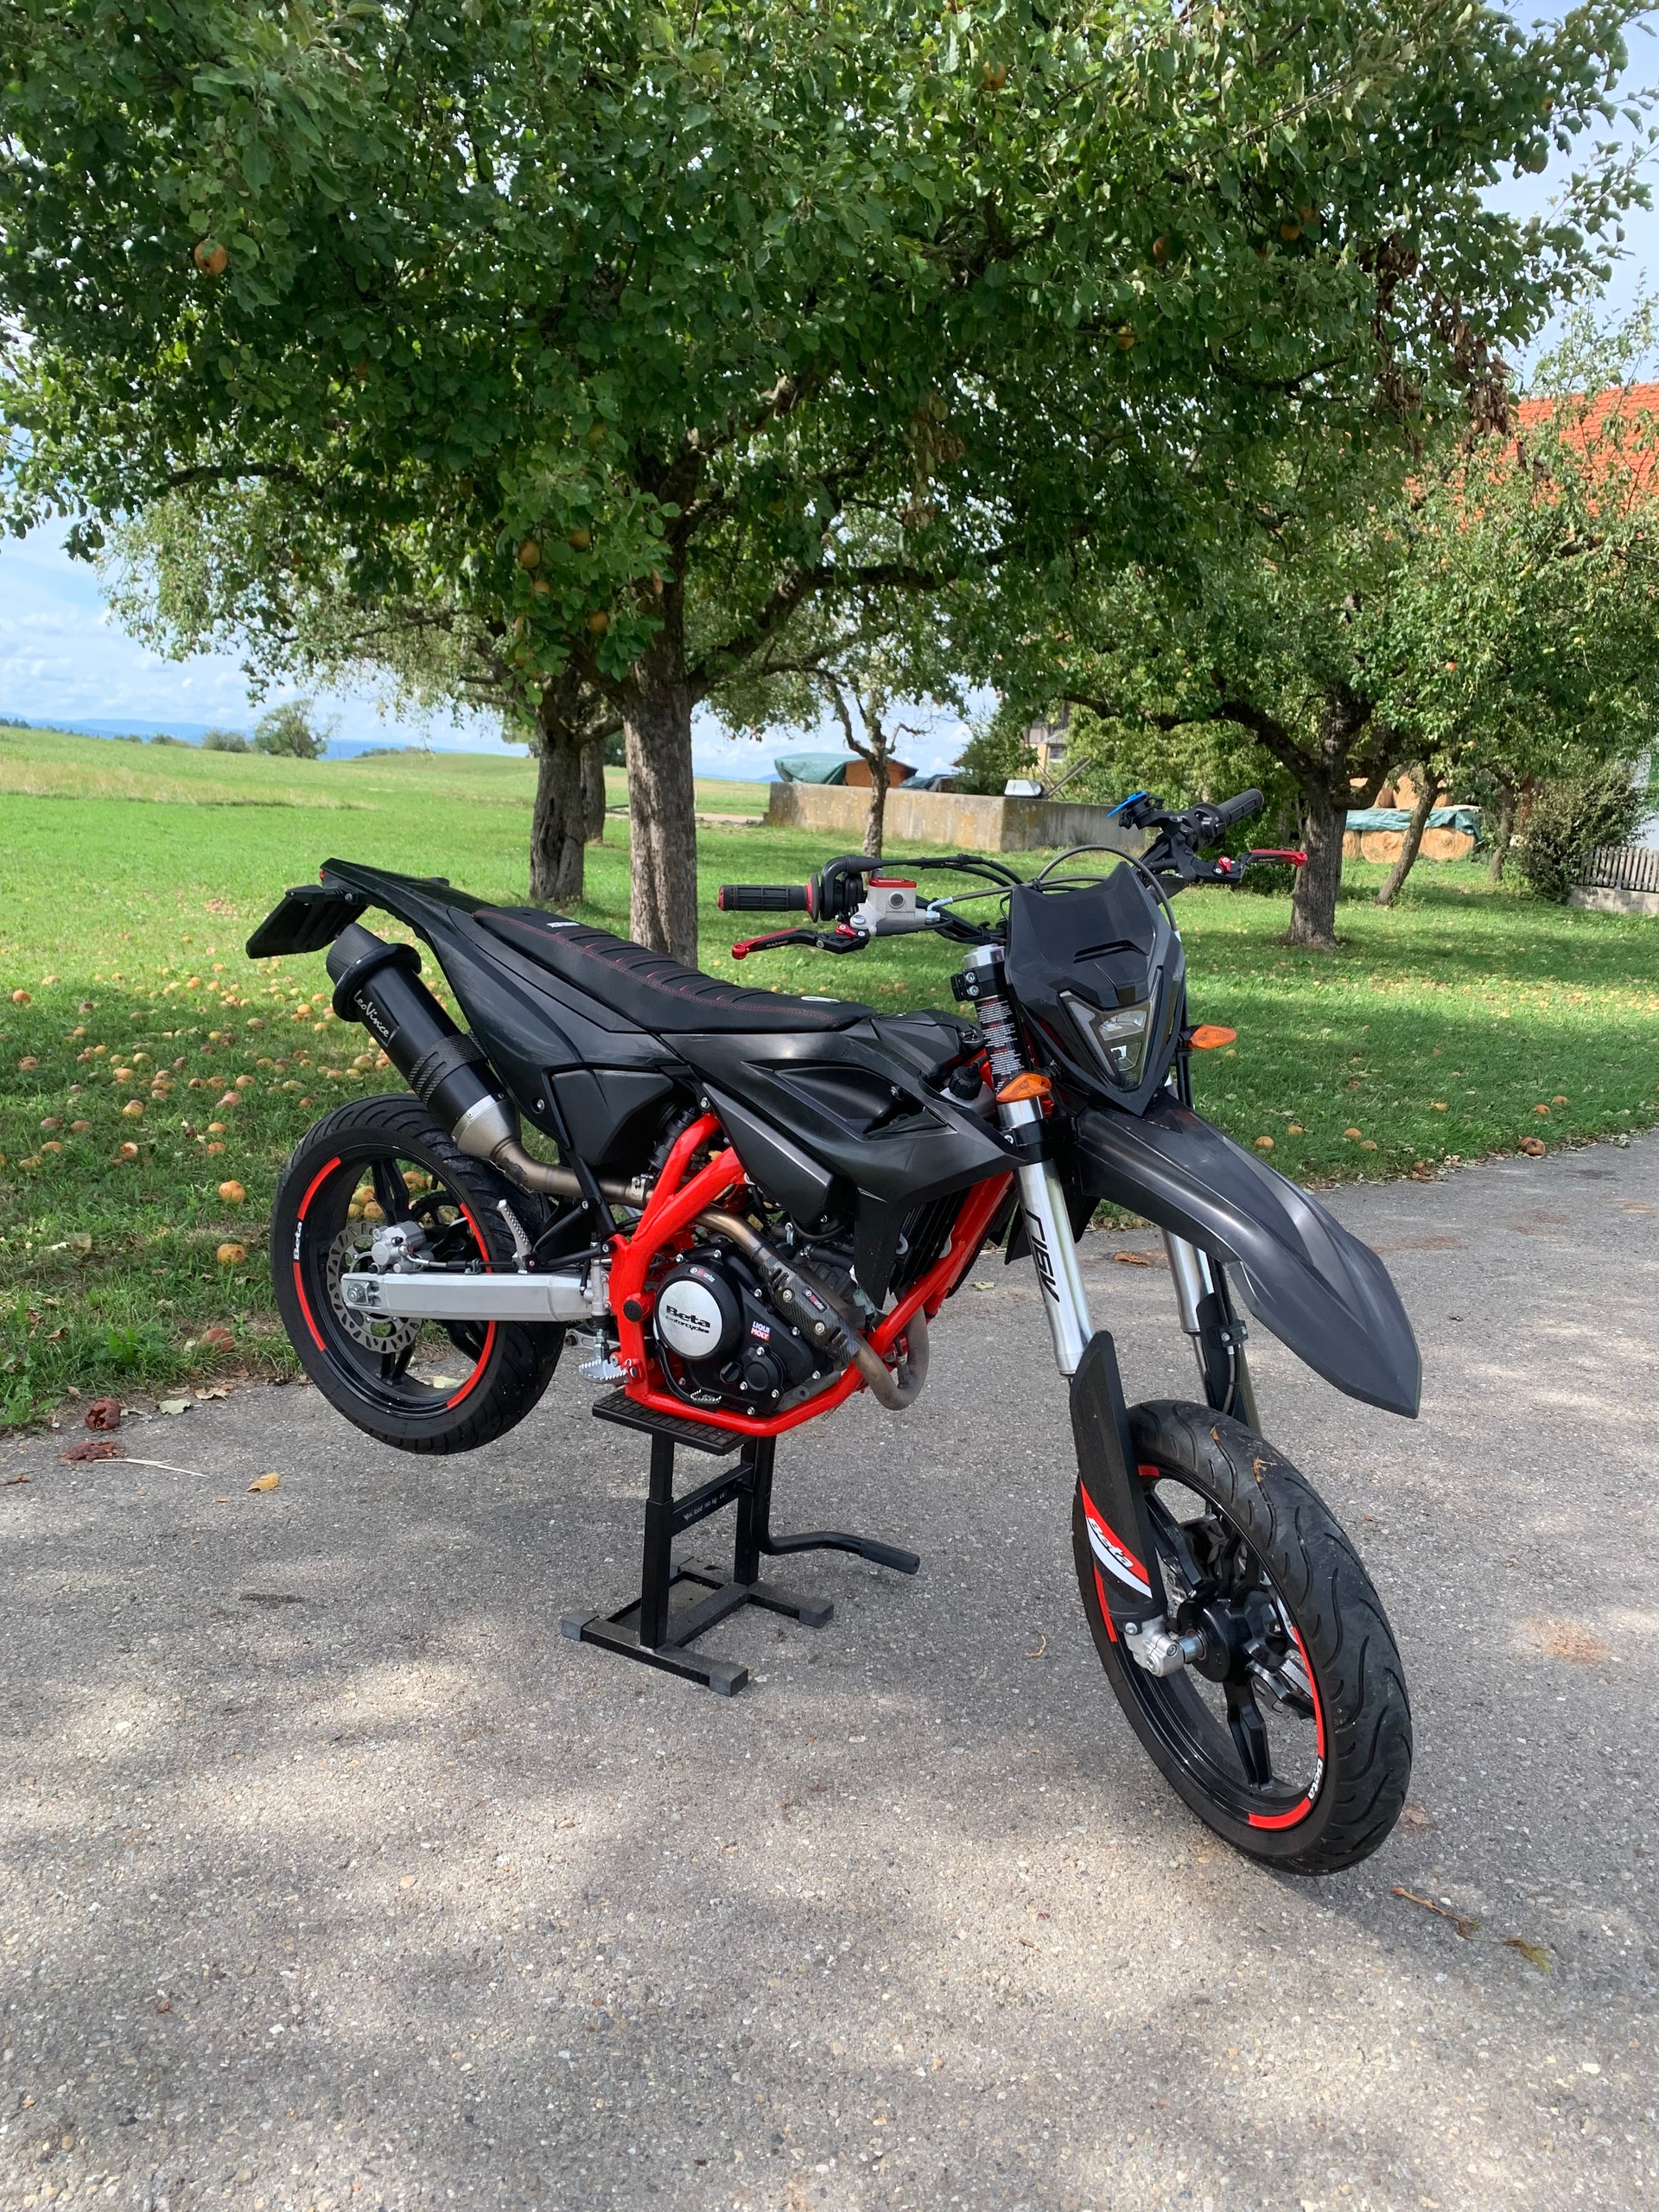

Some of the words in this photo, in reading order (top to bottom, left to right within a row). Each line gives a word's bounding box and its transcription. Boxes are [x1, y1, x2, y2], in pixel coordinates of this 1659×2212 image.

[353, 989, 390, 1038] LeoVince
[666, 1305, 711, 1328] Beta
[753, 1320, 771, 1333] LIQUI
[750, 1327, 771, 1341] MOLY
[1087, 1517, 1135, 1568] Beta
[1307, 1758, 1324, 1800] Beta
